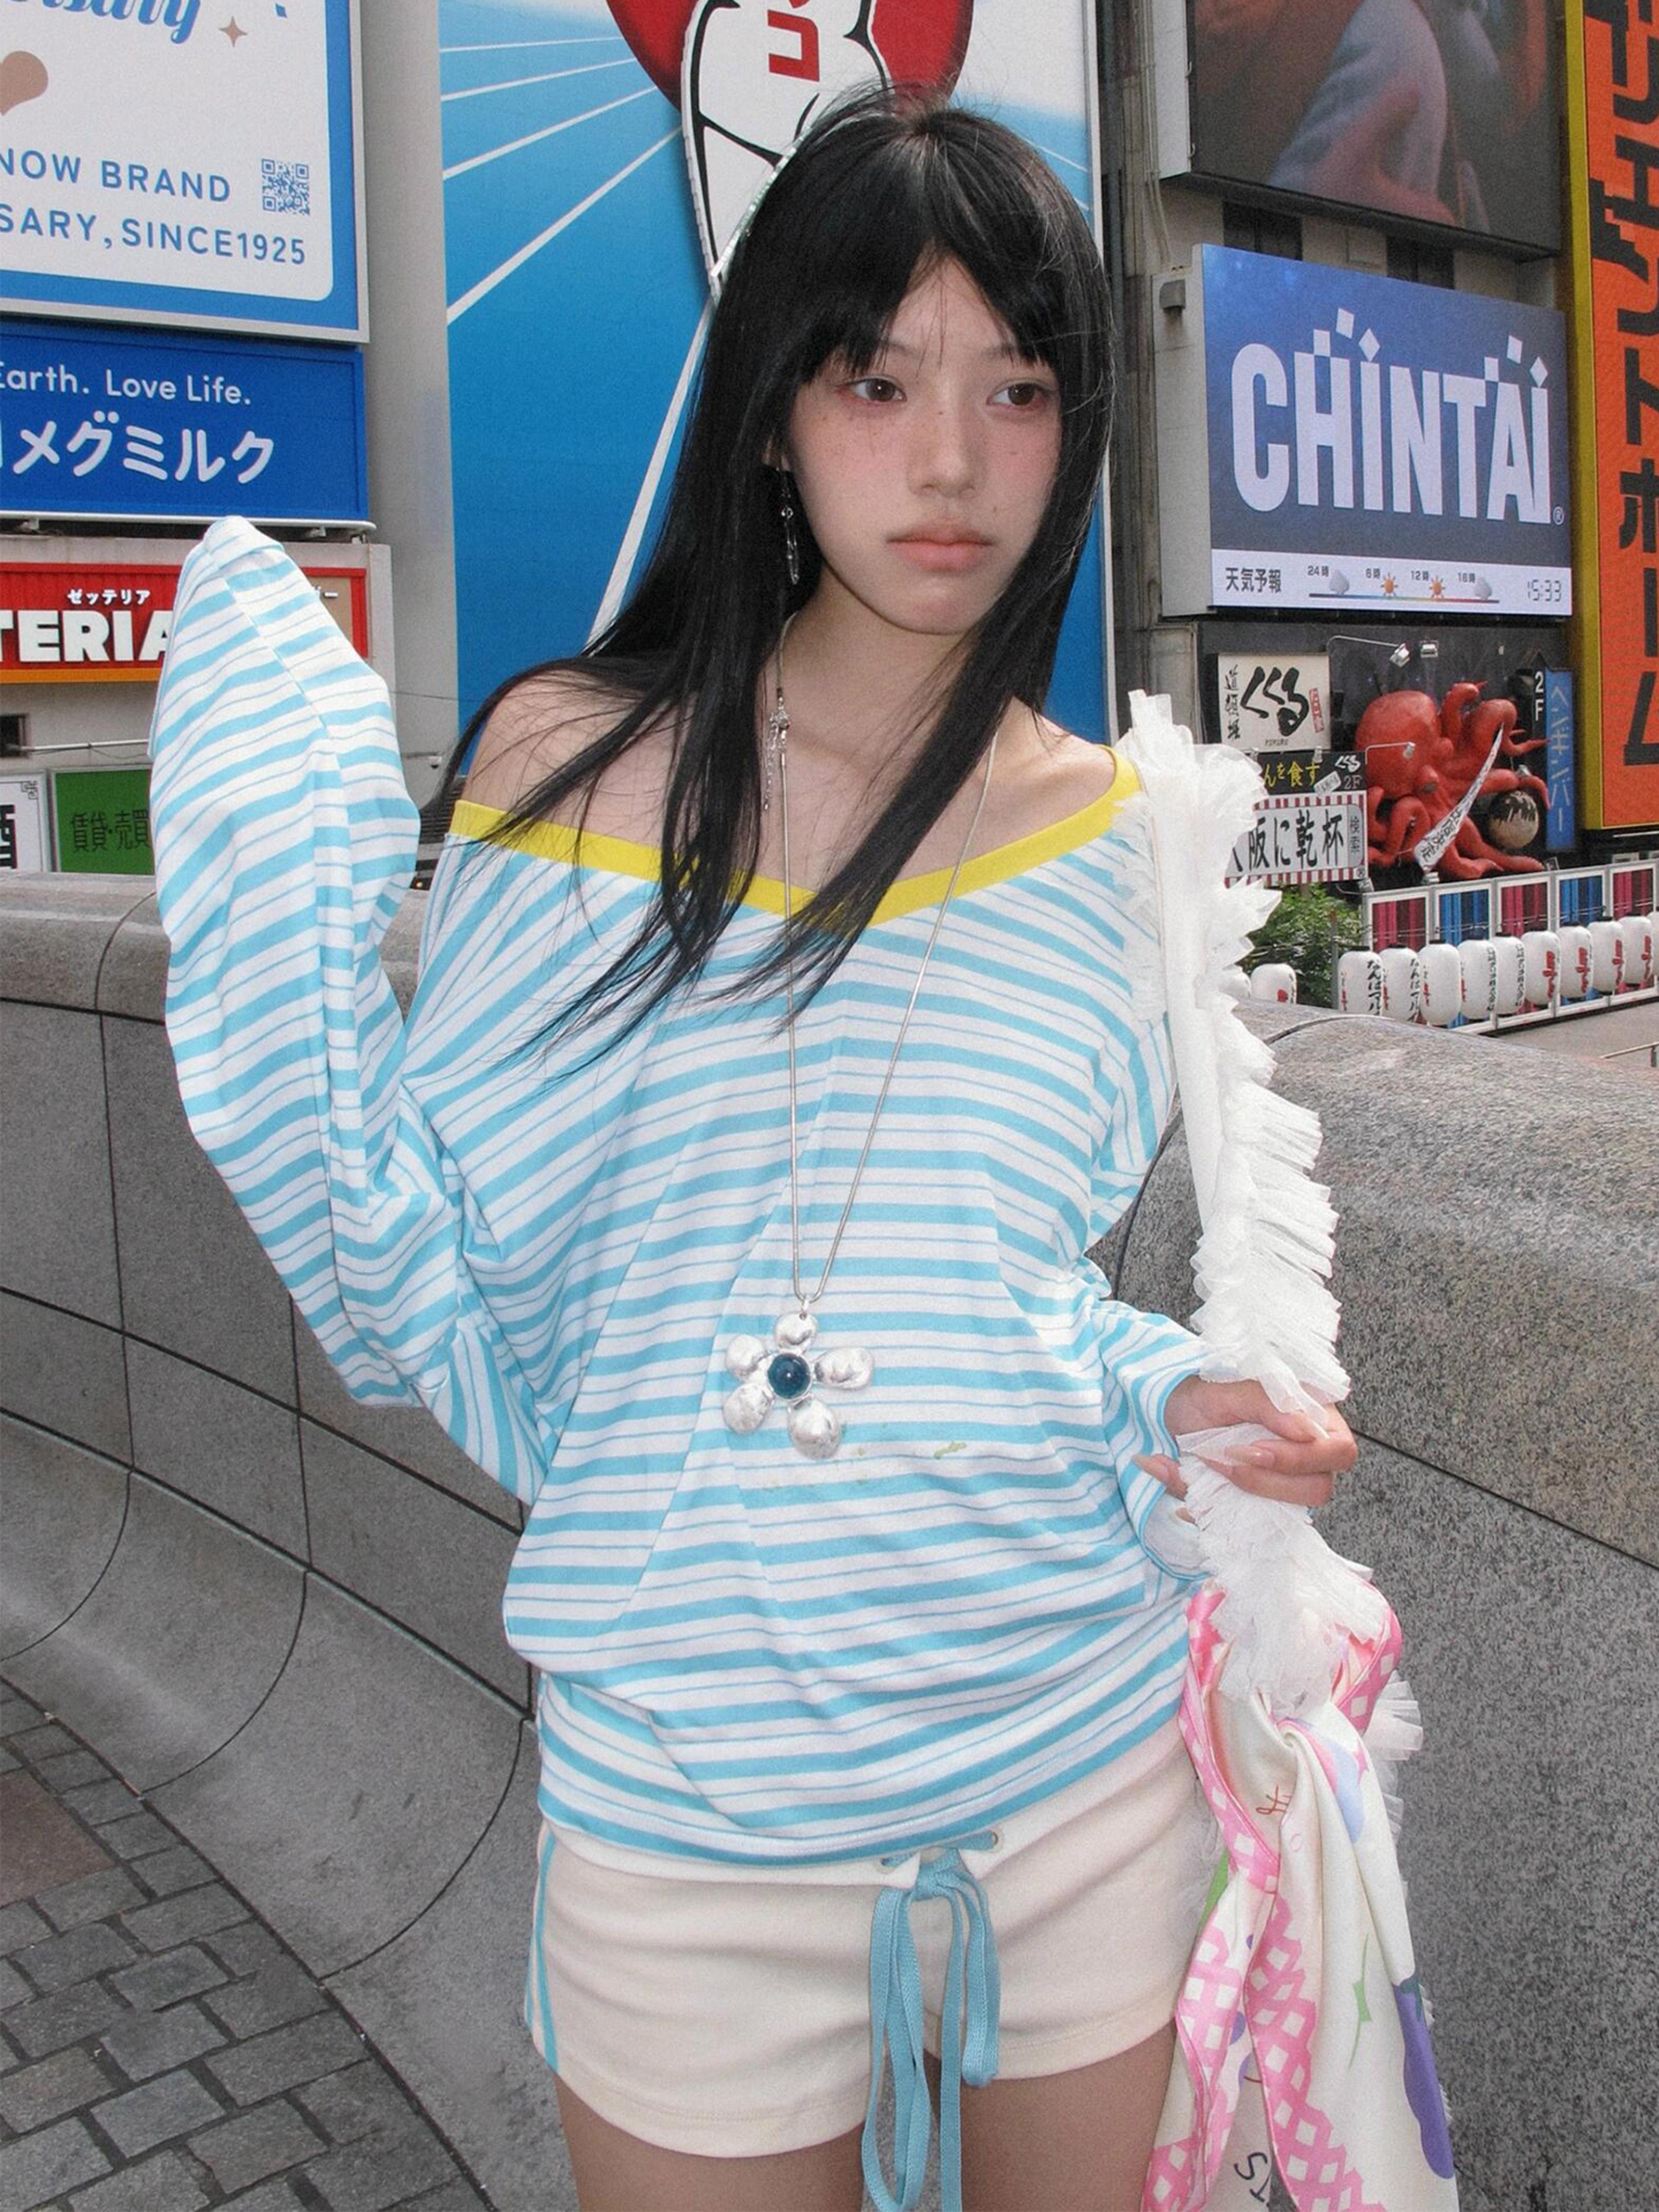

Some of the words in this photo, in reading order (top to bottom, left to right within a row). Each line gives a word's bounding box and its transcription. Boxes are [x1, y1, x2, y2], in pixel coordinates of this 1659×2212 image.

[102, 160, 230, 202] BRAND
[106, 369, 177, 400] Love
[187, 375, 251, 405] Life.
[1231, 308, 1551, 524] CHINTAI
[0, 410, 274, 484] メグミルク
[67, 588, 151, 605] ゼッテリア
[1225, 567, 1281, 594] 天気予報
[1527, 579, 1561, 602] 15:33
[1240, 666, 1309, 737] くくる
[1535, 671, 1545, 721] 2F
[1344, 775, 1363, 789] 2F
[1232, 809, 1344, 872] 阪に乾杯
